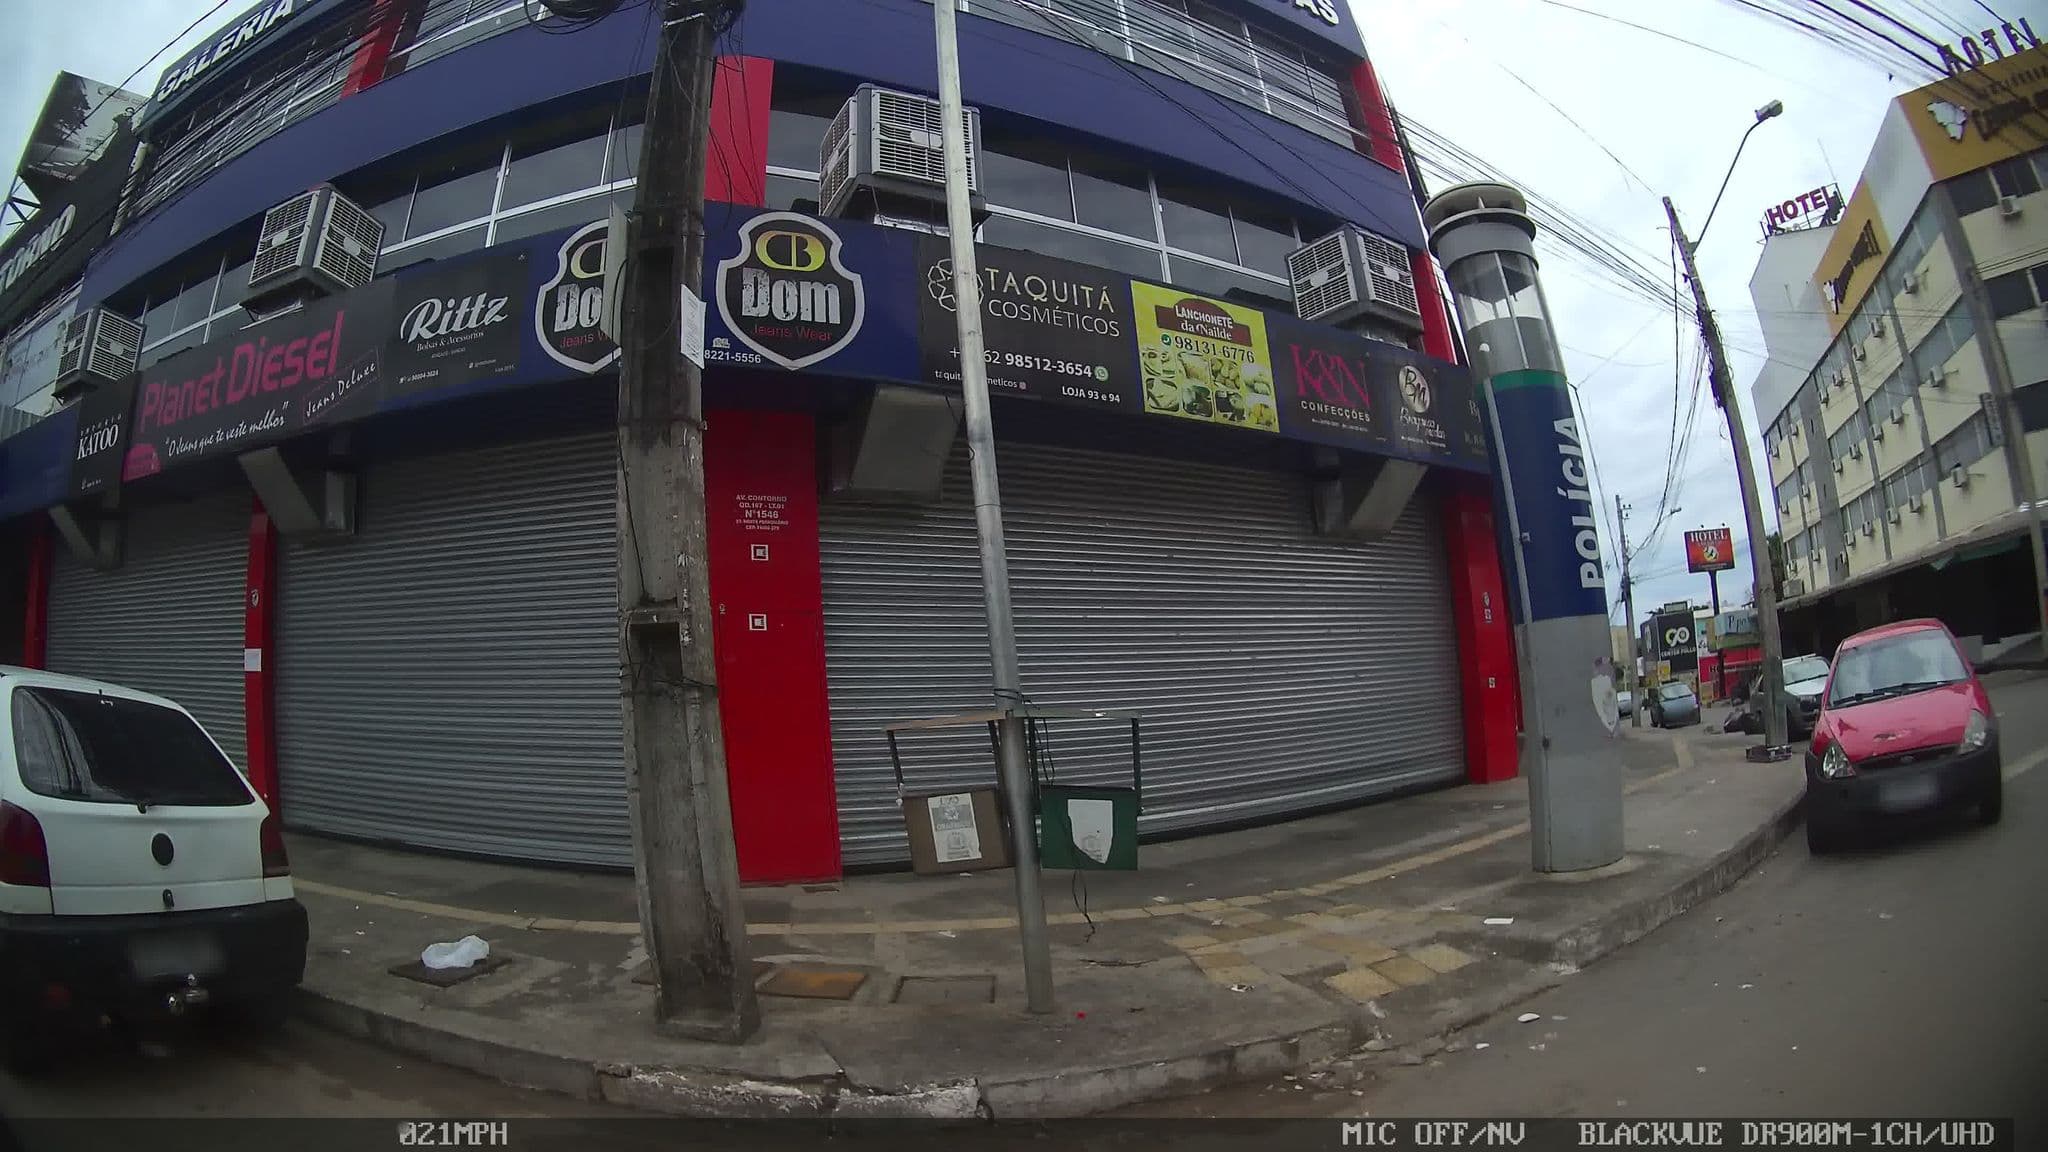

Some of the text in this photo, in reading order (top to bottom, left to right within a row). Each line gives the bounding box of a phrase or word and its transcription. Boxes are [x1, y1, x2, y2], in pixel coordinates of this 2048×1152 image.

[158, 0, 294, 102] GALERIA
[1767, 186, 1834, 230] HOTEL
[985, 267, 1115, 314] TAQUITÁ
[400, 292, 508, 344] Rittz
[988, 299, 1121, 338] COSMÉTICOS
[1175, 305, 1233, 329] LANCHONETE
[1181, 320, 1195, 332] da
[142, 355, 226, 432] Planet
[226, 310, 345, 405] Diesel
[1005, 353, 1092, 378] 98512-3654
[1062, 386, 1086, 398] LOJA
[1087, 390, 1099, 400] 93
[1109, 393, 1120, 403] 94
[77, 424, 119, 460] KATOO
[215, 427, 224, 443] te
[1554, 416, 1604, 589] POLÍCIA
[1690, 529, 1728, 543] HOTEL
